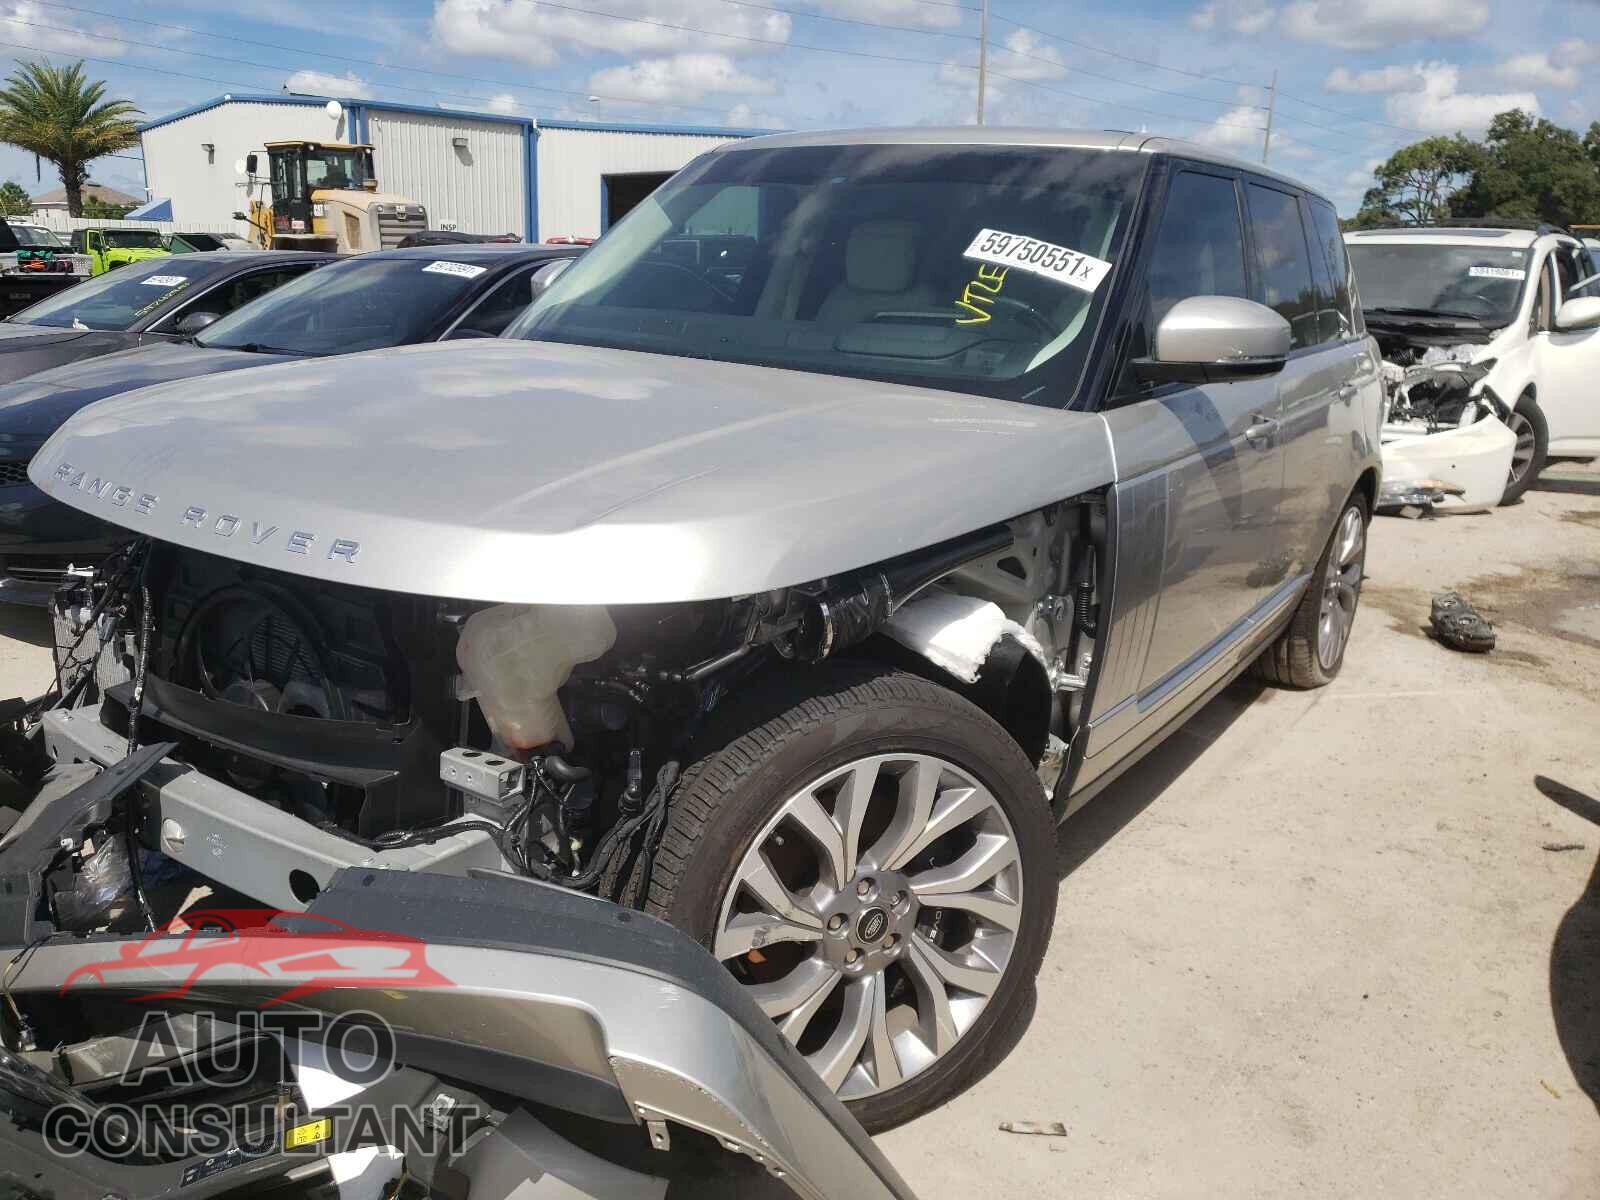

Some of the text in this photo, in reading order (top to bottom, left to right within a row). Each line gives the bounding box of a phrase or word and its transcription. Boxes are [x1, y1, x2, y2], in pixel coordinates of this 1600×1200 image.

[440, 223, 457, 231] INSP
[981, 233, 1085, 276] 59750551
[53, 462, 362, 564] RANGE ROVER
